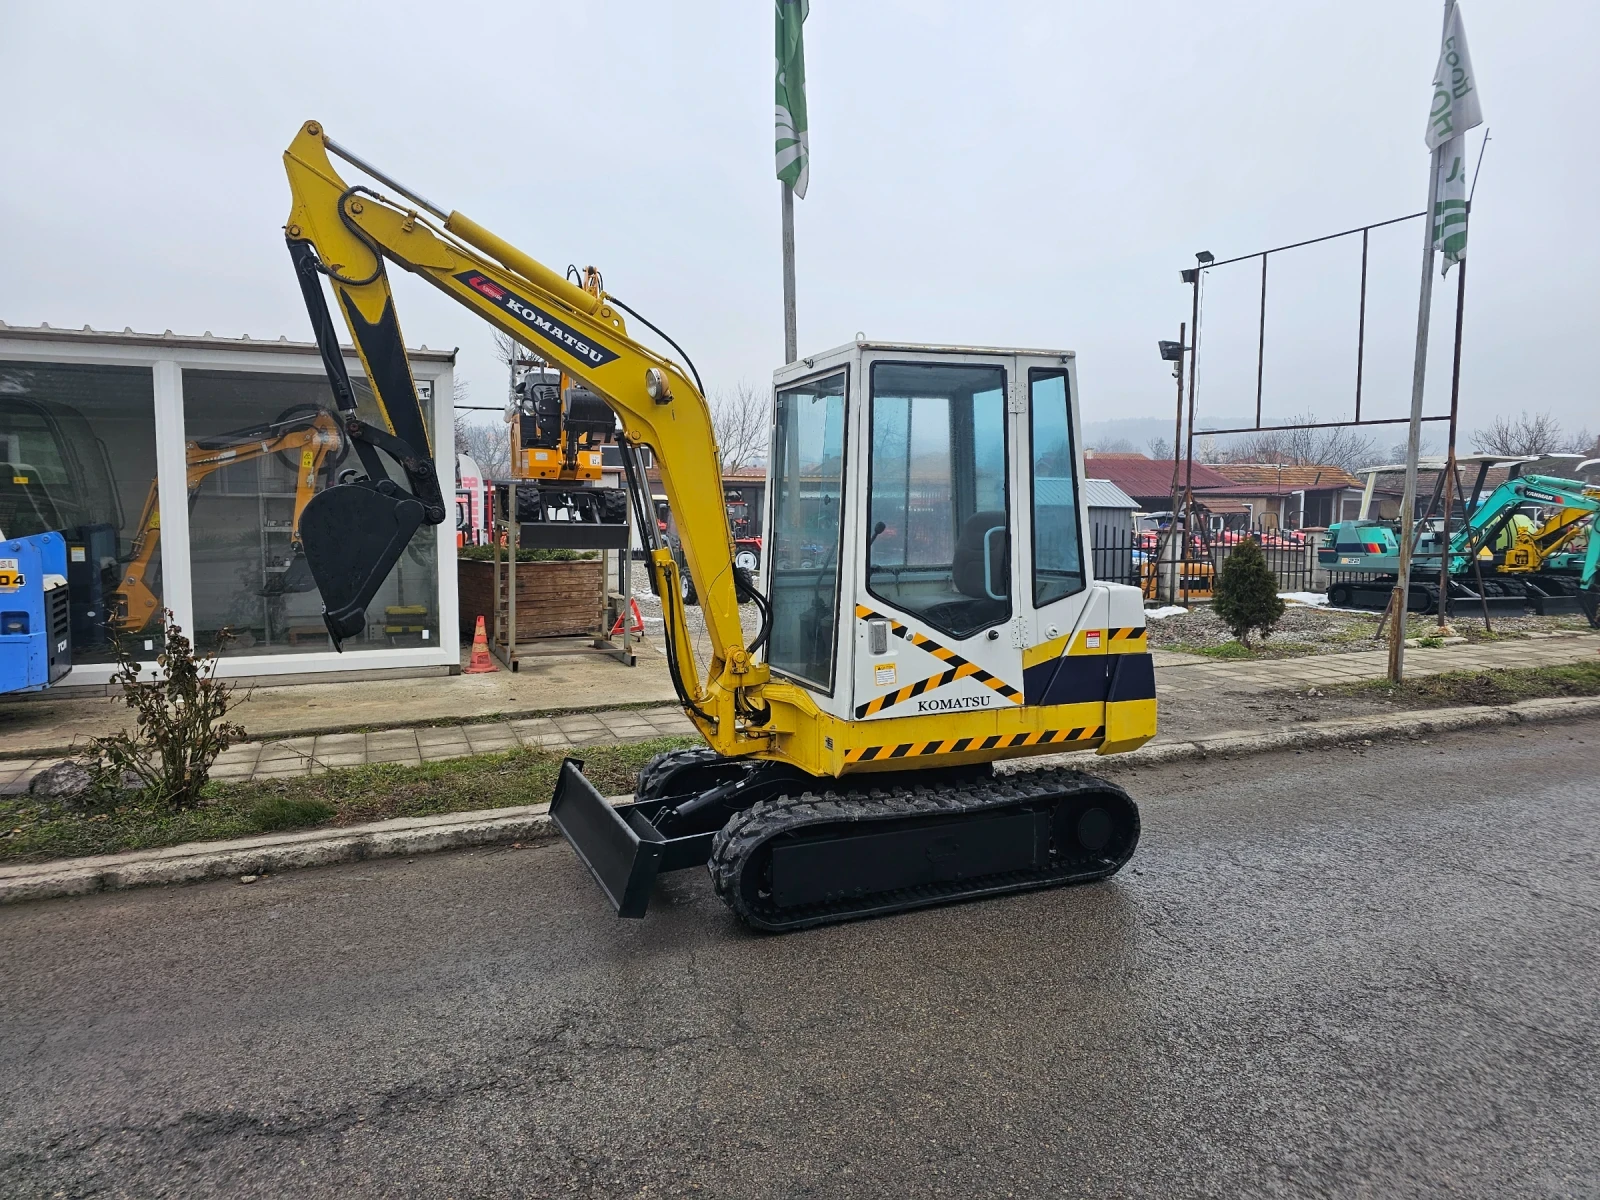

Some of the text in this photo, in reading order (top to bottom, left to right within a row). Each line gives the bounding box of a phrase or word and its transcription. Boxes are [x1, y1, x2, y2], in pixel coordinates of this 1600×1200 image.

[505, 299, 603, 362] KOMATSU
[1526, 491, 1554, 501] YANMAR
[917, 695, 991, 712] KOMATSU
